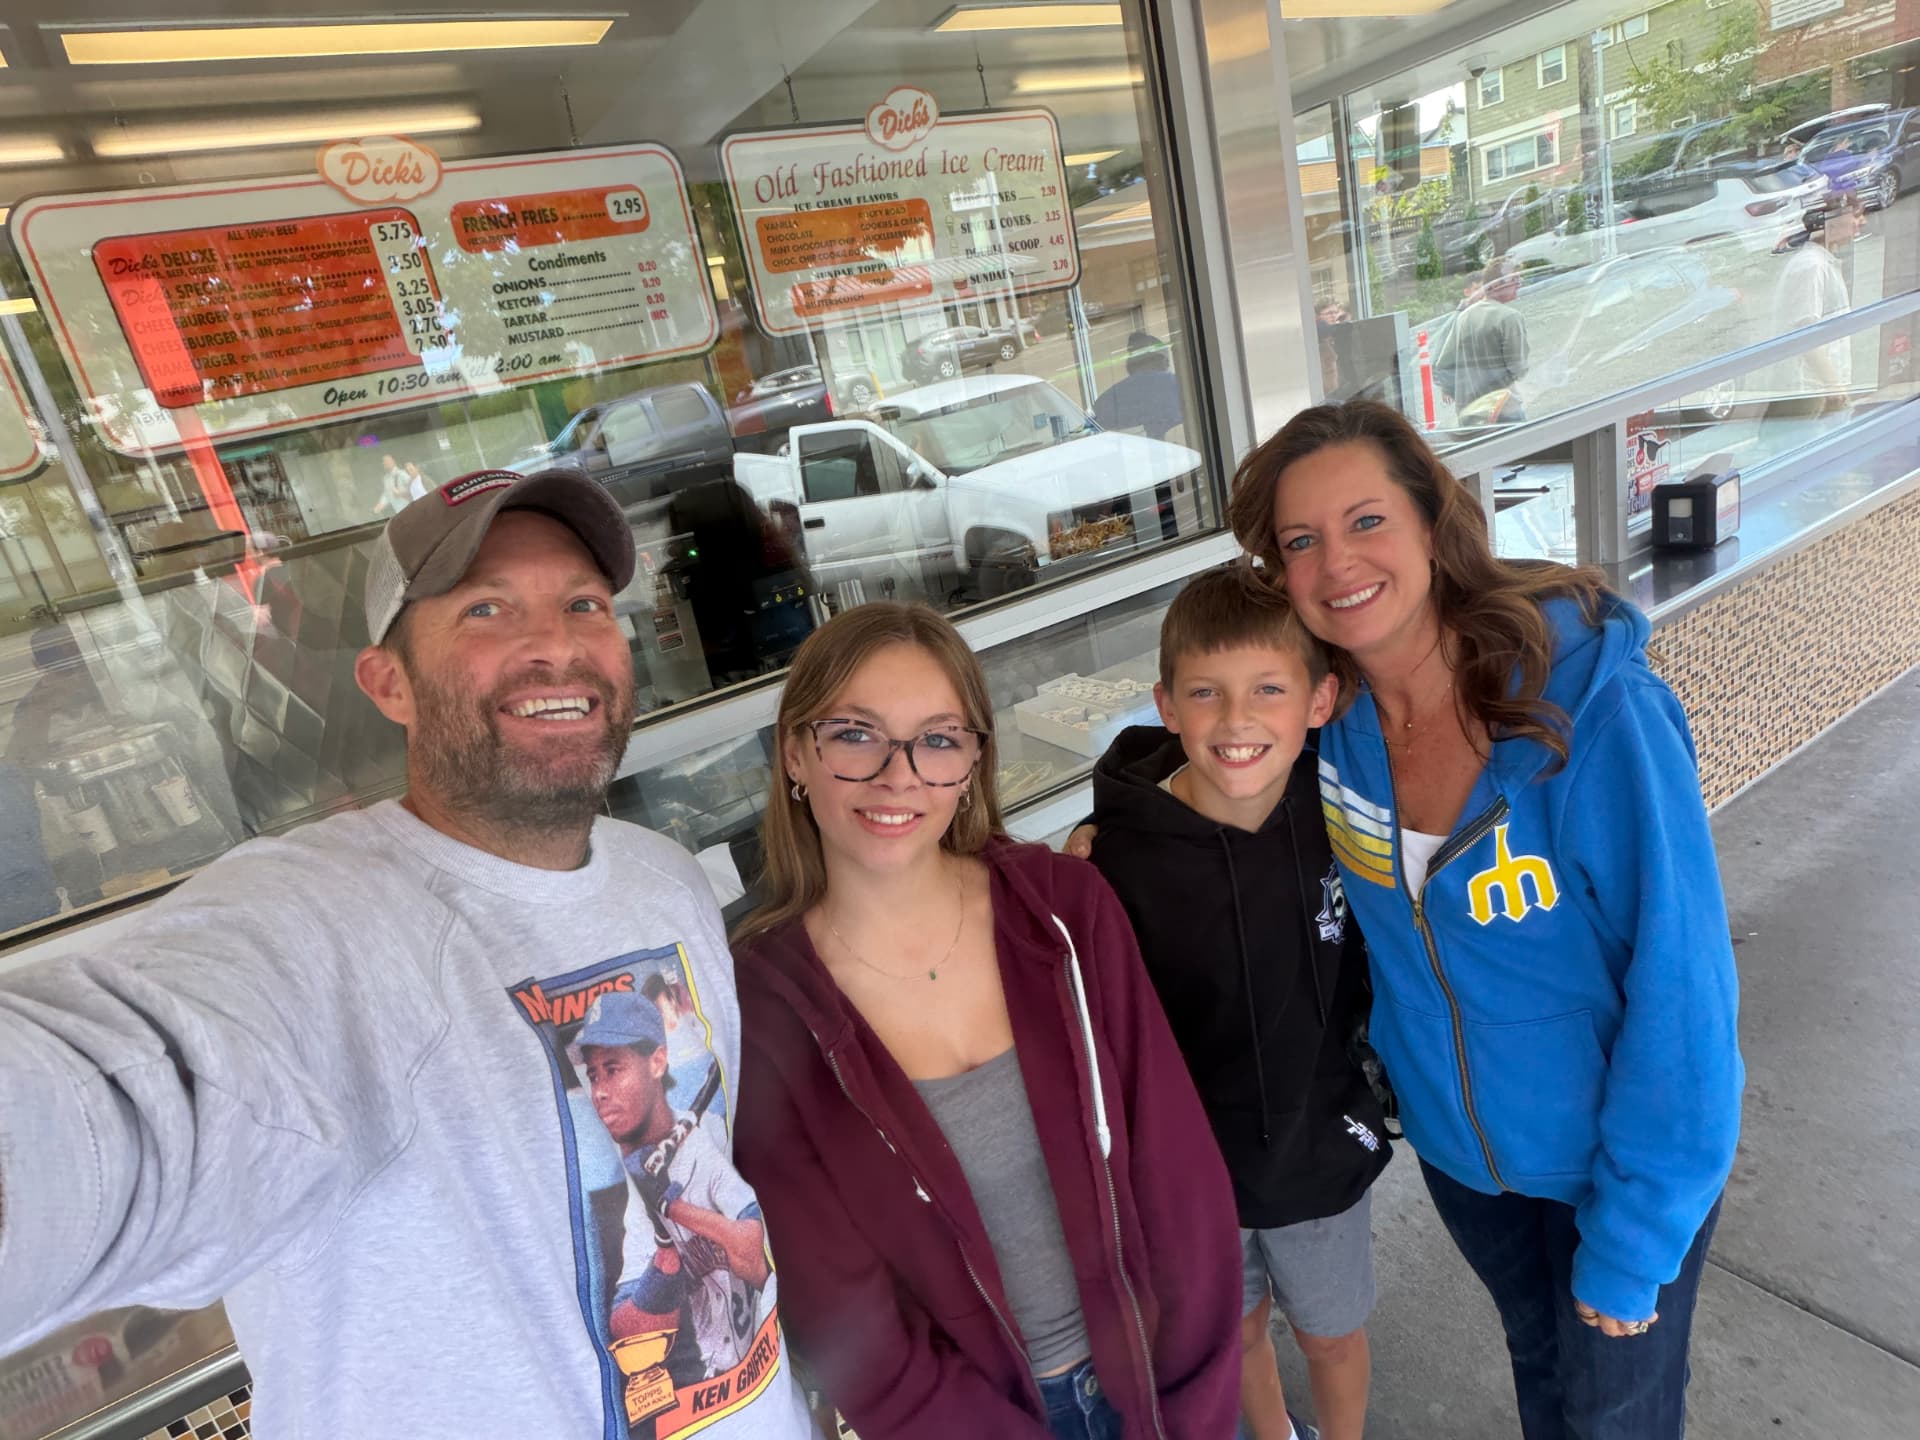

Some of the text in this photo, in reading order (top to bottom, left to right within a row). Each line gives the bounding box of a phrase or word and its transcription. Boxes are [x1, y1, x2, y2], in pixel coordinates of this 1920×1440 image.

[878, 96, 930, 140] Dick's
[341, 151, 426, 186] Dick's
[755, 147, 1045, 203] Old Fashioned Ice Cream
[794, 191, 899, 212] ICE CREAM FLAVORS
[462, 197, 642, 233] FRENCH FRIES 2.95
[960, 218, 996, 234] SIGLE
[1001, 214, 1032, 228] CONES
[276, 224, 298, 236] BEEF
[108, 222, 411, 275] Dick's DELUXE 5.75
[1009, 238, 1040, 252] SCOOP
[528, 250, 607, 272] Condiments
[396, 278, 430, 297] 3.25
[492, 261, 657, 295] ONIONS 0.20
[402, 297, 436, 316] 3.05
[497, 291, 551, 311] KETCHU
[409, 316, 442, 335] 2.70
[502, 312, 549, 329] TARTAR
[508, 327, 565, 345] MUSTARD
[323, 387, 368, 407] Open
[377, 371, 430, 396] 10:30
[436, 370, 461, 385] am
[494, 356, 533, 374] 2:00
[538, 353, 563, 366] am
[692, 1332, 776, 1414] KEN GRIFFEY,
